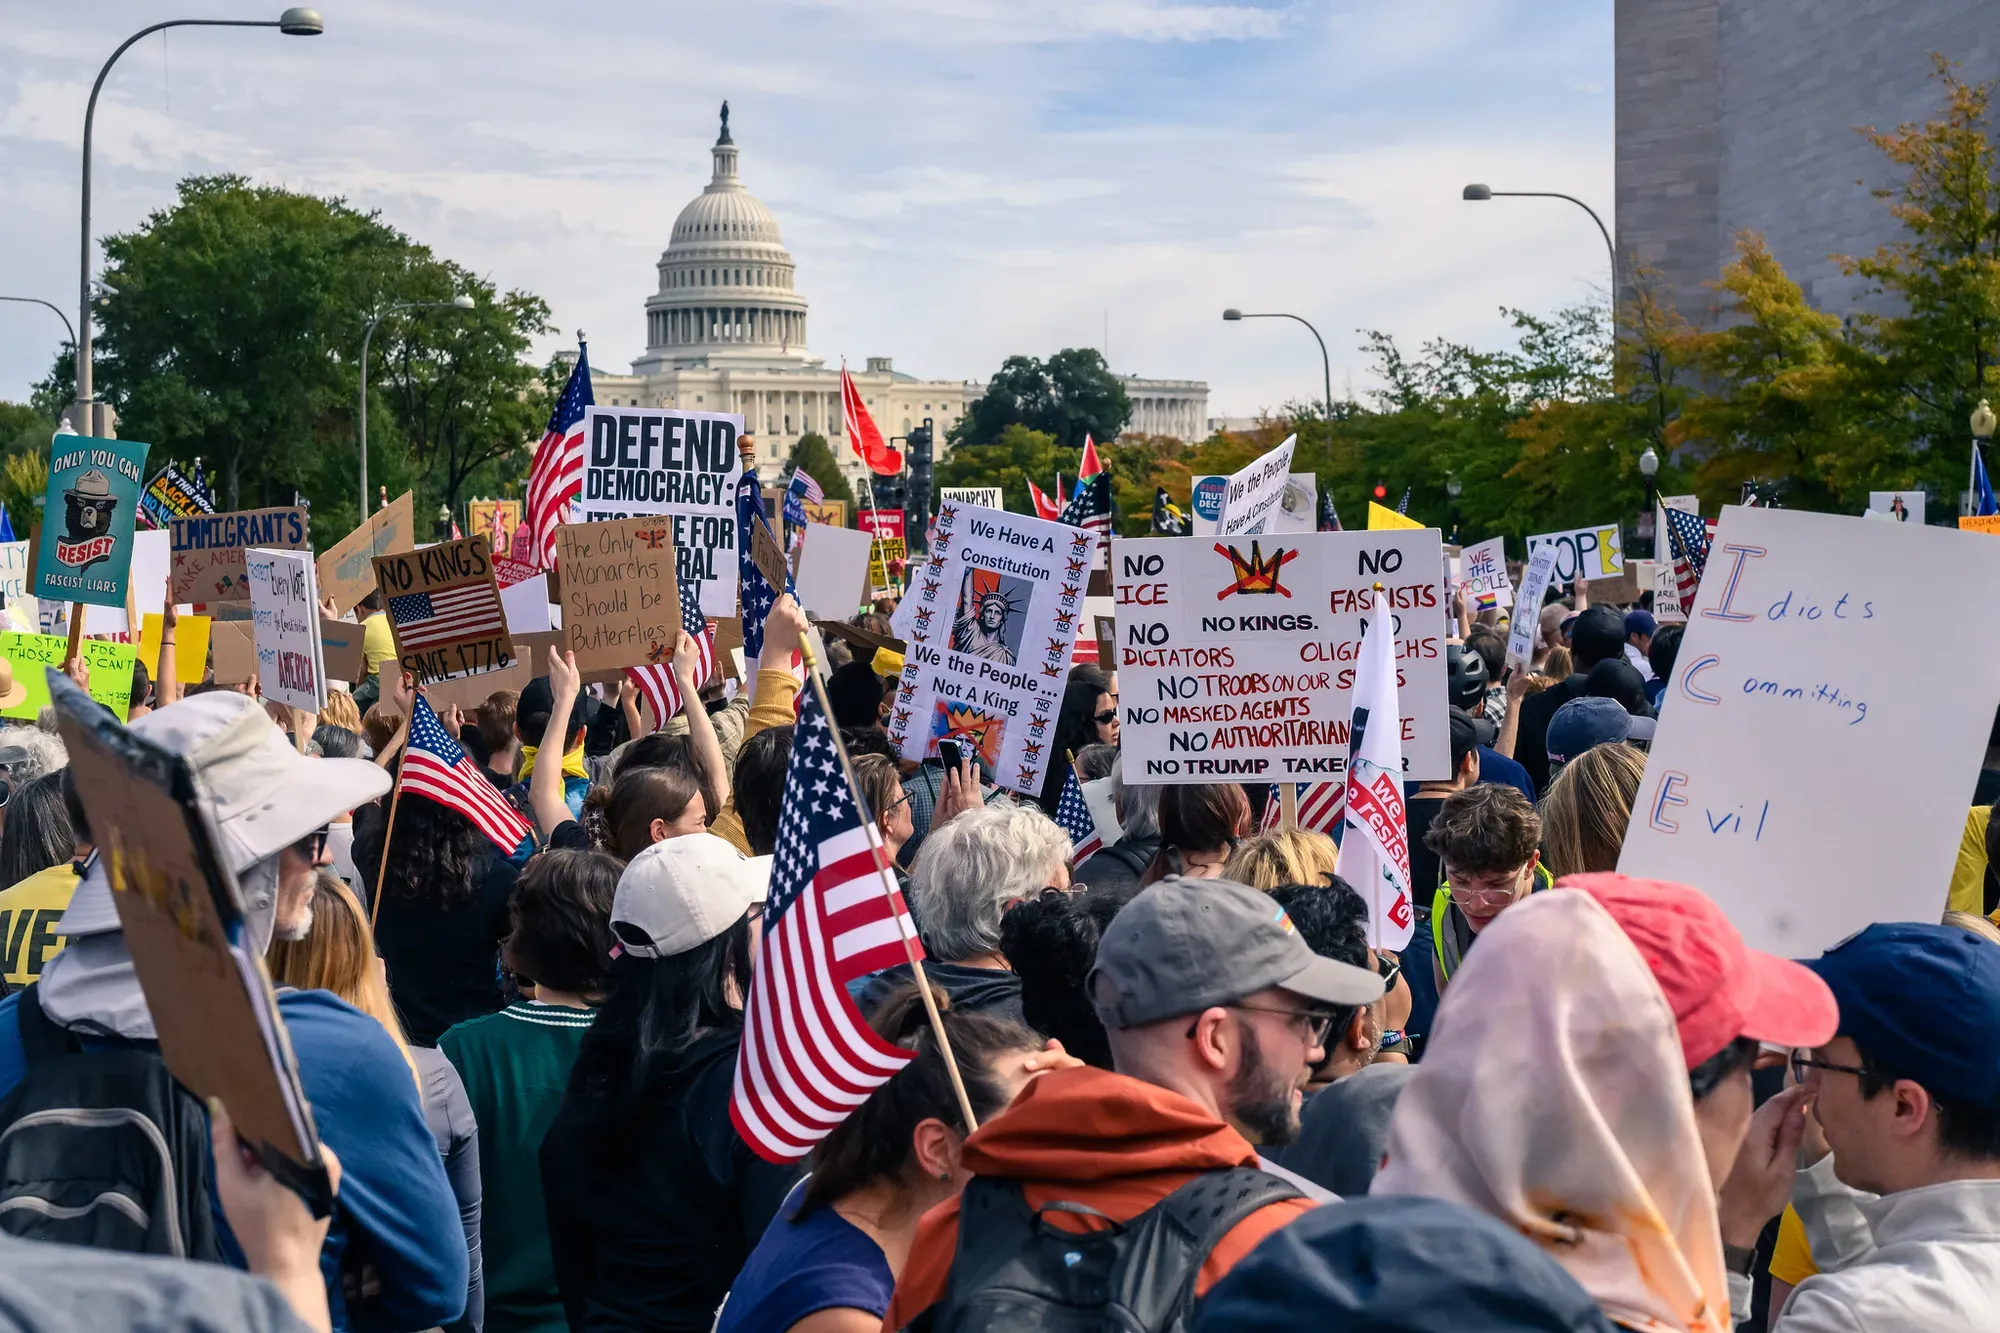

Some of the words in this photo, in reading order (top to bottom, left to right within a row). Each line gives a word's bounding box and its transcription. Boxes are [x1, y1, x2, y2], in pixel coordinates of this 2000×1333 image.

[591, 414, 736, 473] DEFEND
[54, 450, 85, 474] ONLY
[90, 450, 116, 468] YOU
[118, 457, 140, 483] CAN
[175, 477, 196, 496] THIS
[192, 494, 215, 515] HOU
[586, 468, 734, 507] DEMOCRACY:
[1200, 492, 1223, 500] TRUT
[1201, 483, 1224, 491] FIGH
[1229, 481, 1244, 504] We
[1247, 472, 1261, 494] the
[143, 494, 157, 510] NO
[1199, 500, 1221, 508] DECA
[865, 515, 900, 525] POWER
[941, 517, 953, 525] NO
[1245, 507, 1251, 525] A
[171, 512, 303, 551] IMMIGRANTS
[600, 526, 633, 558] Only
[691, 516, 734, 550] FOR
[872, 527, 894, 539] TO
[970, 519, 995, 539] We
[998, 526, 1039, 550] Have
[1041, 537, 1054, 553] A
[58, 537, 113, 564] RESIST
[935, 541, 948, 549] NO
[1072, 545, 1086, 554] NO
[1469, 548, 1491, 564] WE
[0, 547, 26, 569] TY
[379, 558, 413, 594] NO
[418, 541, 486, 586] KINGS
[498, 559, 511, 568] NO
[511, 562, 537, 575] KINGS
[674, 547, 718, 580] RAL
[961, 547, 1050, 581] Constitution
[1124, 554, 1164, 577] NO
[1358, 548, 1403, 576] NO
[1468, 559, 1496, 577] THE
[173, 559, 205, 600] MAKE
[211, 549, 246, 566] AMER
[566, 556, 659, 586] Monarchs
[929, 565, 942, 574] NO
[1067, 570, 1081, 579] NO
[1657, 570, 1675, 585] TH
[45, 573, 83, 588] FASCIST
[87, 579, 117, 593] LIARS
[1460, 572, 1508, 595] PEOPLE
[571, 589, 627, 617] Should
[640, 585, 661, 609] be
[923, 590, 936, 599] NO
[1061, 596, 1075, 604] NO
[1116, 583, 1168, 606] ICE
[917, 618, 929, 627] NO
[1056, 621, 1070, 630] NO
[1202, 616, 1236, 632] NO
[1240, 614, 1319, 632] KINGS.
[14, 634, 23, 646] I
[91, 644, 116, 656] FOR
[571, 617, 665, 652] Butterflies
[1129, 622, 1169, 646] NO
[8, 648, 54, 664] THOSE
[97, 658, 133, 670] CAN'T
[915, 645, 941, 666] We
[948, 655, 975, 676] the
[1048, 650, 1062, 659] NO
[1122, 647, 1235, 668] DICTATORS
[1300, 637, 1438, 662] OLIGCHS
[277, 649, 316, 696] AMERICA
[402, 648, 456, 685] SINCE
[456, 638, 509, 676] 1776
[905, 668, 918, 676] NO
[900, 693, 912, 701] NO
[933, 677, 962, 698] Not
[965, 686, 977, 703] A
[983, 690, 1020, 717] King
[1157, 675, 1198, 701] NO
[1198, 672, 1270, 697] TROOPS
[1272, 676, 1294, 693] ON
[1297, 672, 1330, 692] OUR
[1036, 700, 1050, 709] NO
[1127, 707, 1159, 725] NO
[1163, 704, 1237, 724] MASKED
[1240, 697, 1311, 721] AGENTS
[894, 720, 907, 728] NO
[1030, 726, 1044, 735] NO
[1169, 731, 1208, 752] NO
[1024, 752, 1038, 761] NO
[1147, 760, 1180, 775] NO
[1184, 758, 1270, 774] TRUMP
[1282, 757, 1409, 773] TAKER
[1019, 778, 1033, 787] NO
[1374, 779, 1401, 819] we
[1650, 770, 1769, 842] Evil
